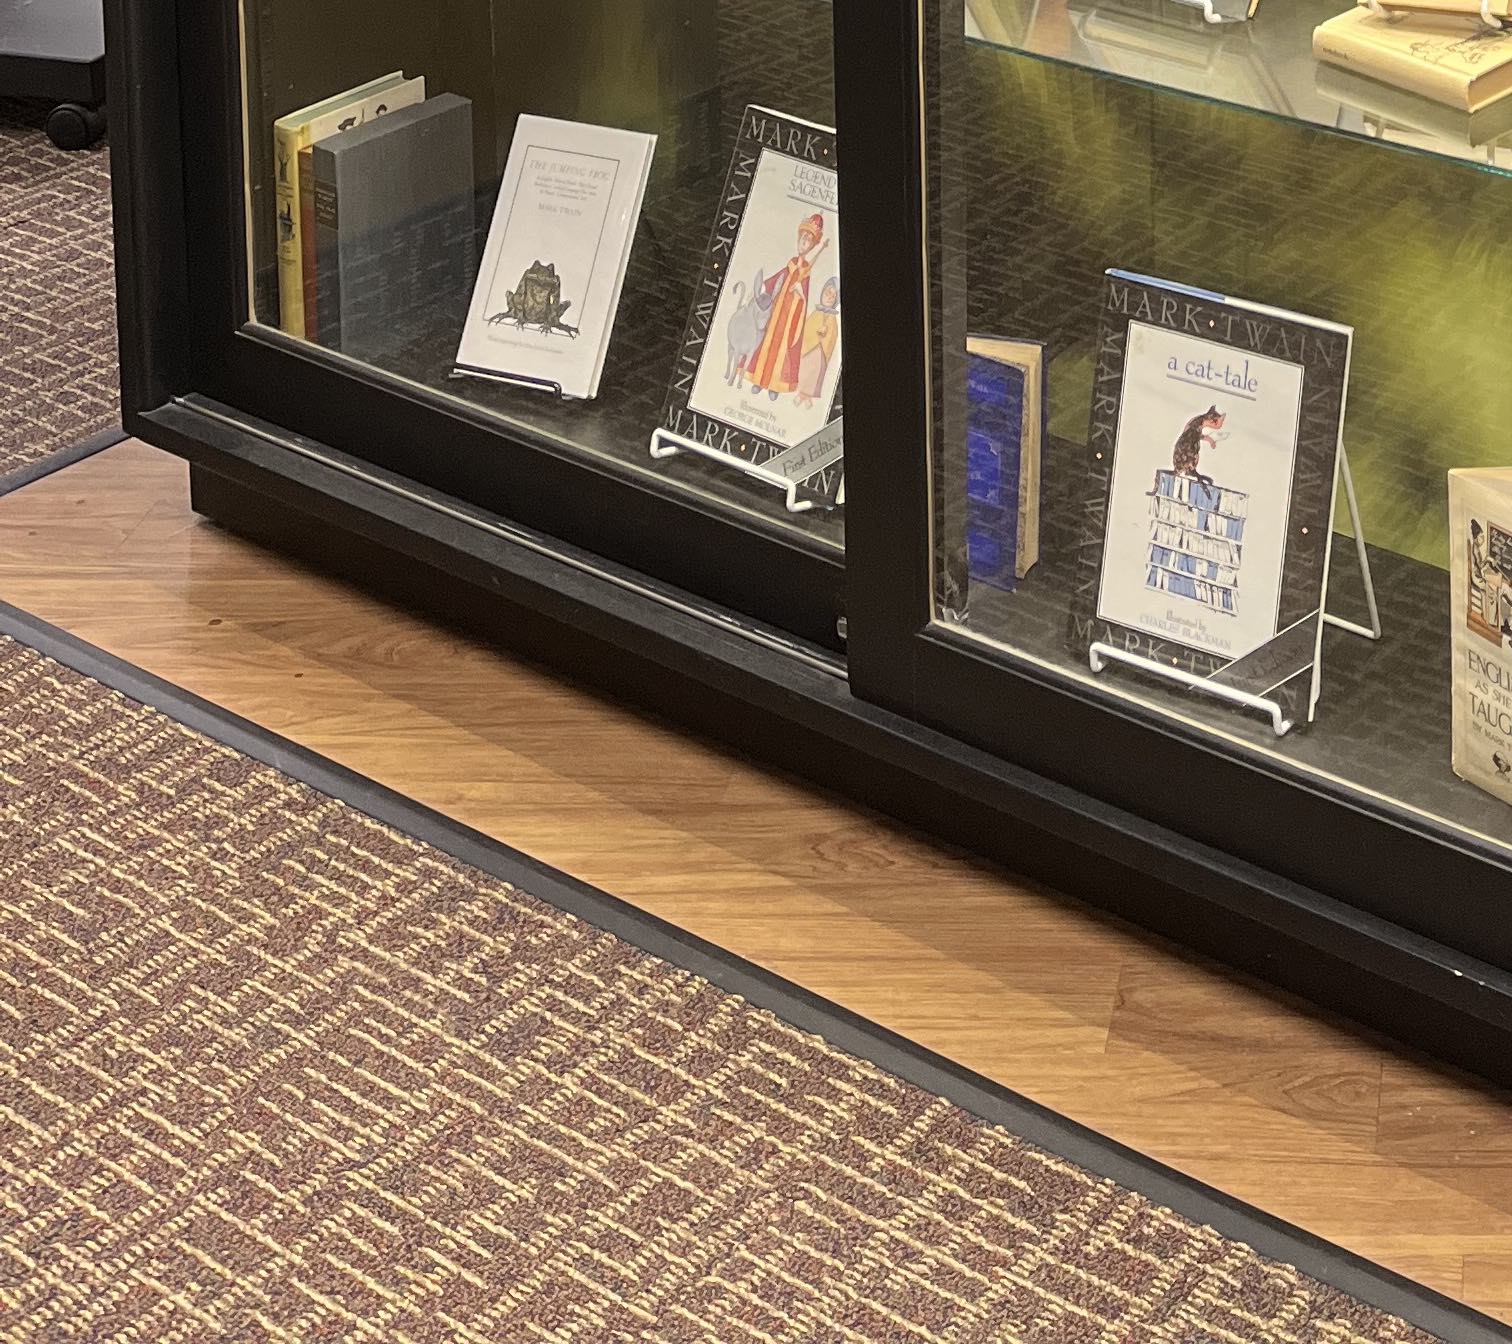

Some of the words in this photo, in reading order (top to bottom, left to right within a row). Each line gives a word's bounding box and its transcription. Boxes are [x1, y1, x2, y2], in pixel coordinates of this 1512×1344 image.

[744, 115, 822, 162] MARK
[787, 178, 838, 206] SAGENFE
[792, 164, 837, 191] LEGEND
[711, 149, 757, 258] MARK
[1107, 283, 1204, 333] MARK
[1220, 312, 1337, 369] TWAIN
[1090, 327, 1125, 448] MARK
[1167, 355, 1178, 372] a
[1184, 359, 1259, 394] cat-tale
[665, 404, 739, 458] MARK
[782, 455, 807, 478] First
[807, 436, 843, 462] Edition
[1474, 679, 1489, 696] AS
[1492, 688, 1512, 710] SHE
